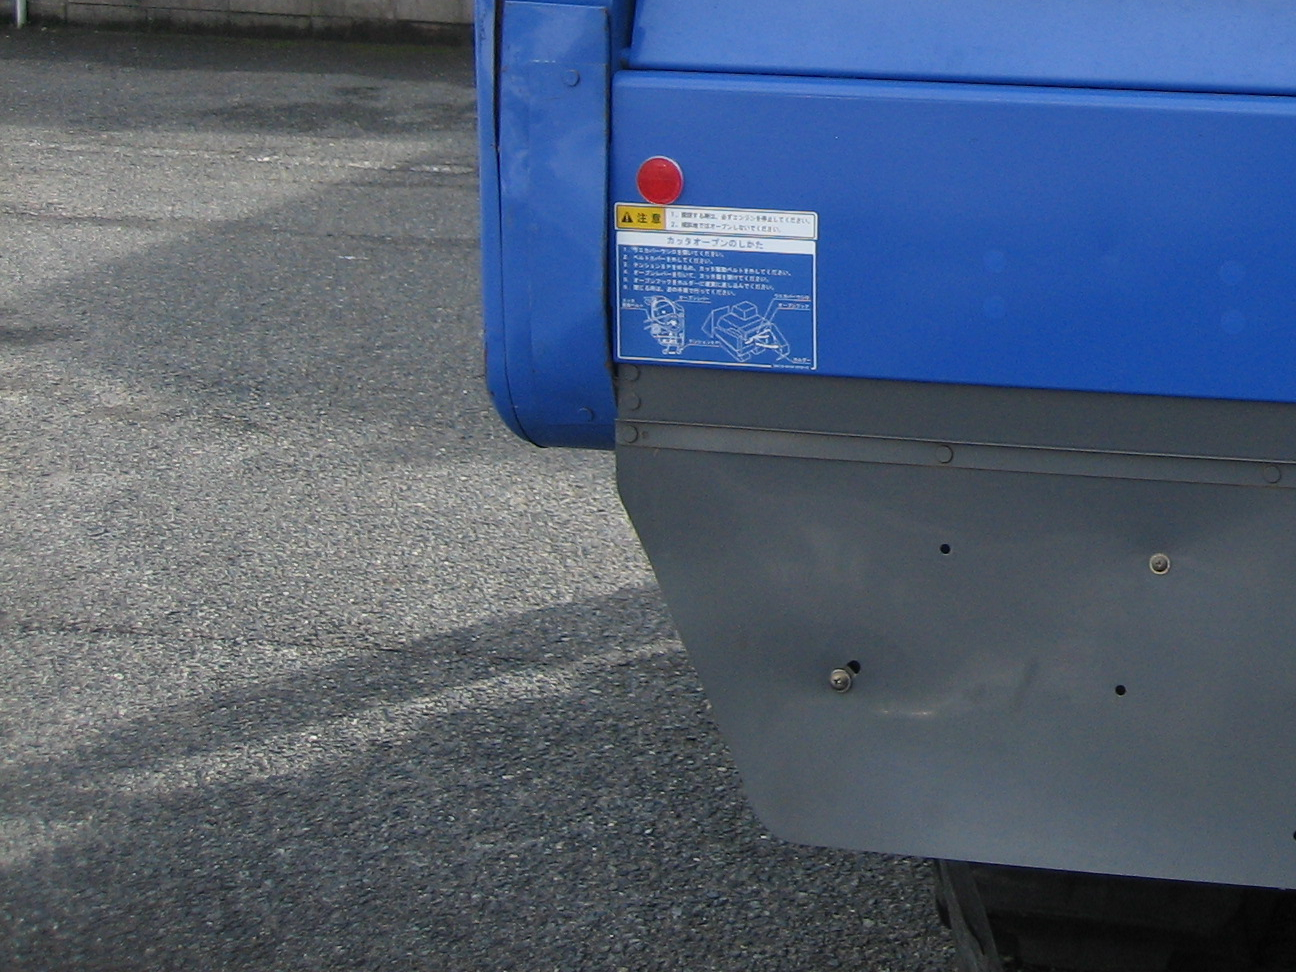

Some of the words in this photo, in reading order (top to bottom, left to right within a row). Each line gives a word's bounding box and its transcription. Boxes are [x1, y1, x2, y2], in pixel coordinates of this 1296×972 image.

[637, 211, 662, 224] 注意
[667, 236, 764, 249] カッタオープンのしかた
